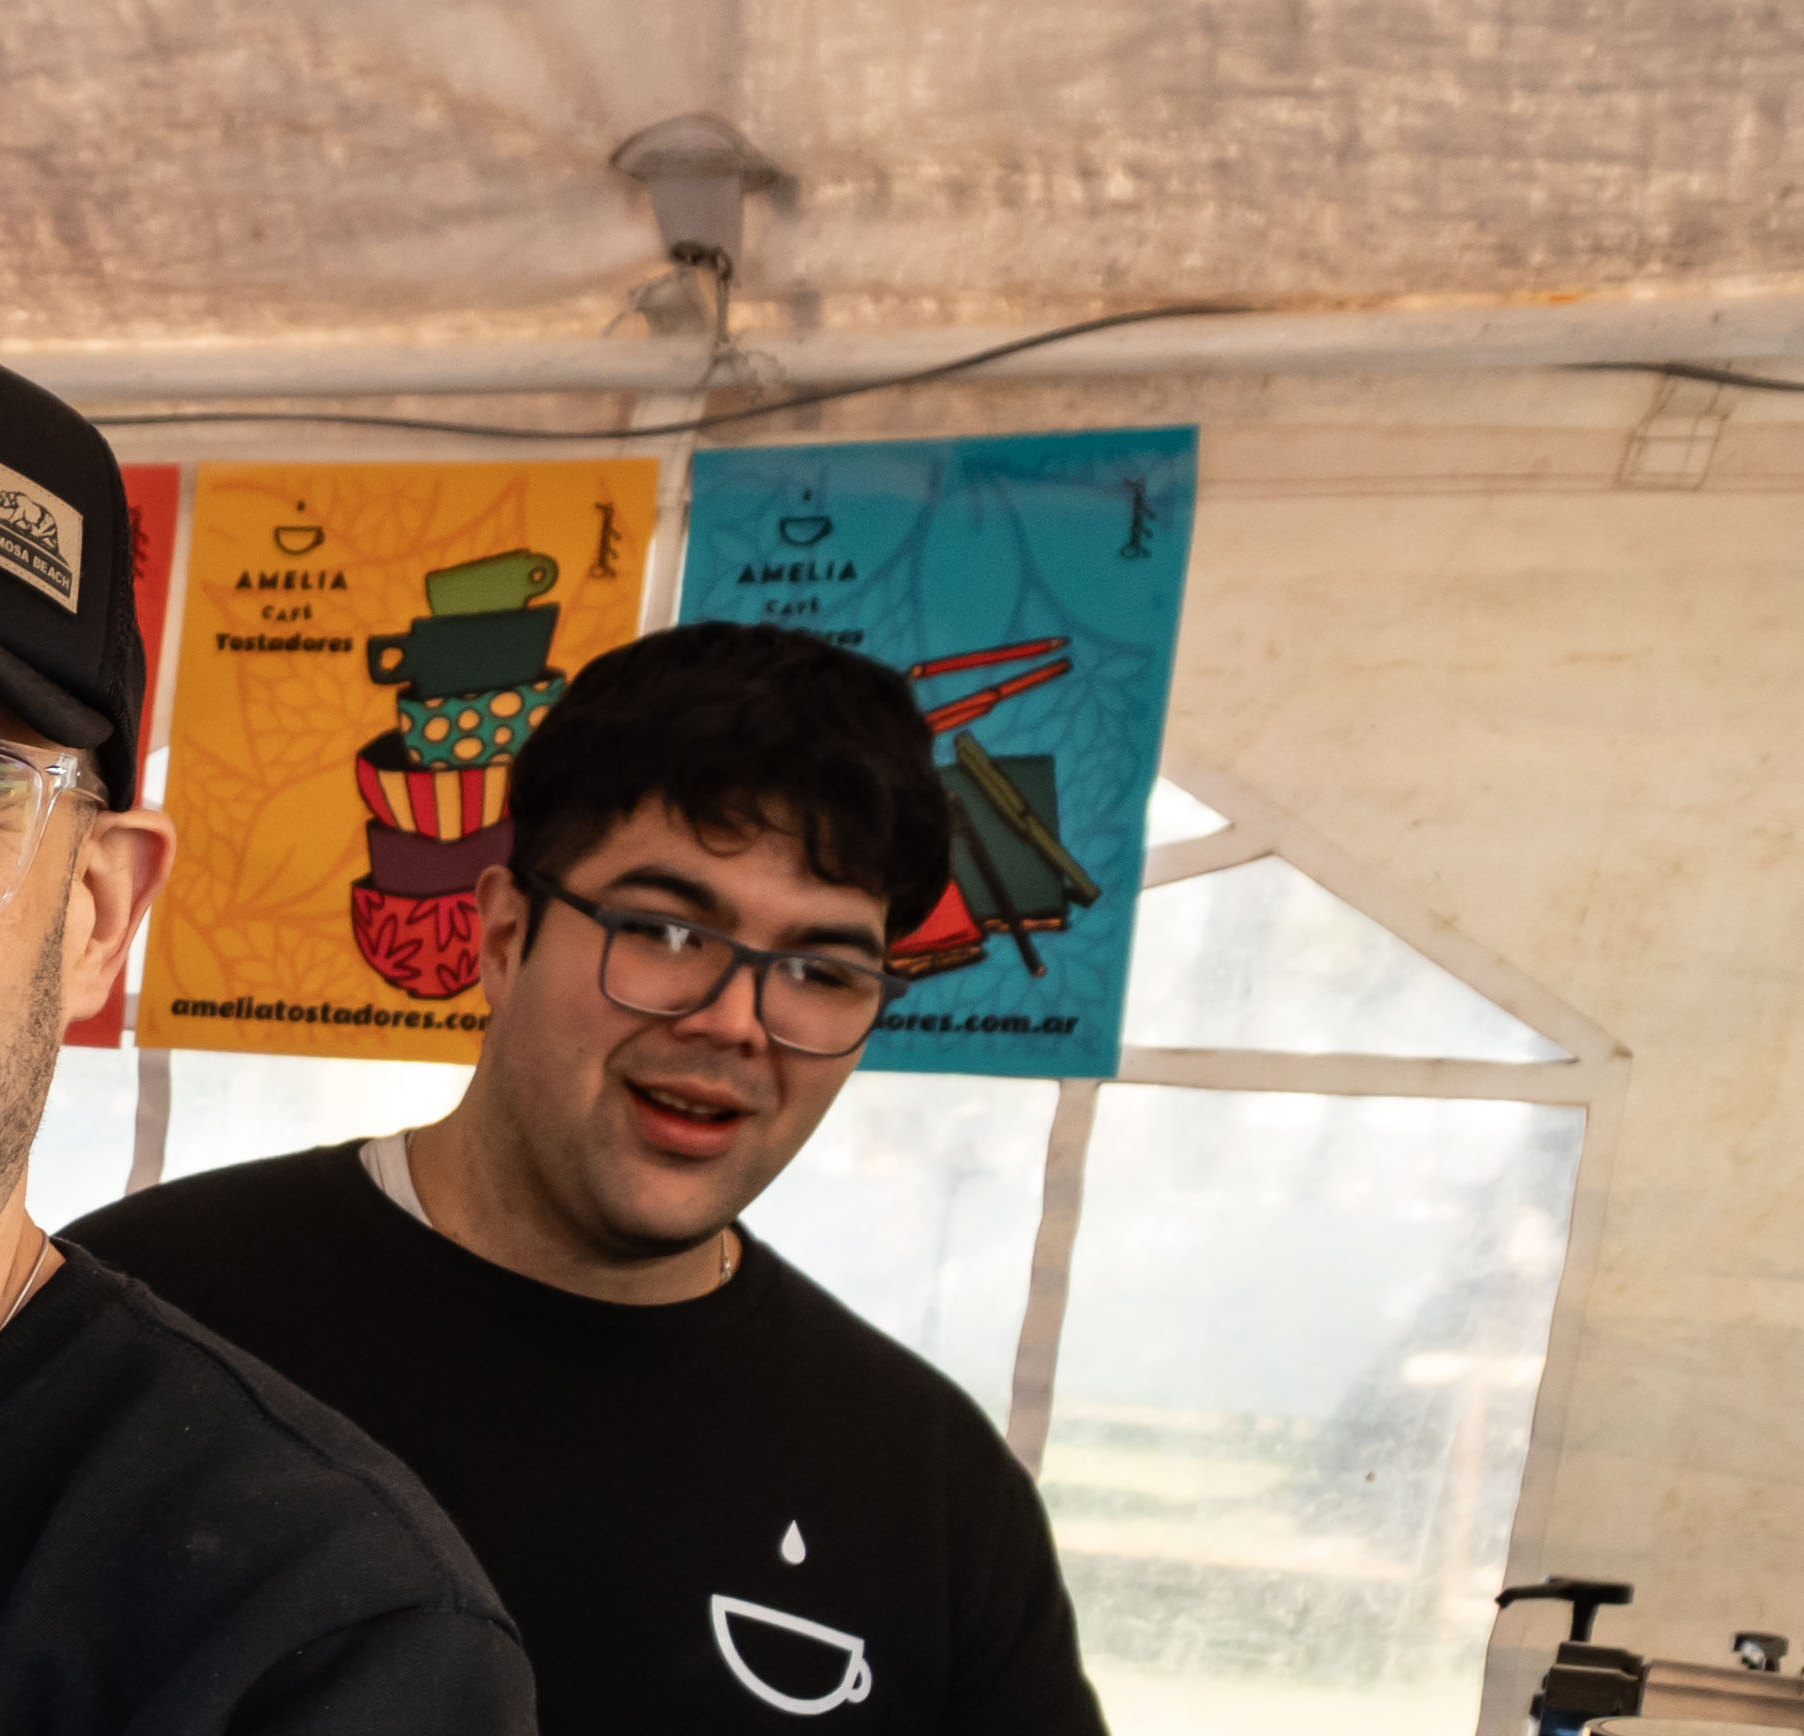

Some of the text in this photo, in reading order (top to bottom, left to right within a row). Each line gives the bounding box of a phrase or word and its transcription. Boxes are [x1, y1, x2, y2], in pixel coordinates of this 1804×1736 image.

[32, 556, 71, 590] BEACH
[235, 568, 348, 590] AMELIA
[737, 559, 858, 585] AMELIA
[215, 632, 354, 653] Tostadores
